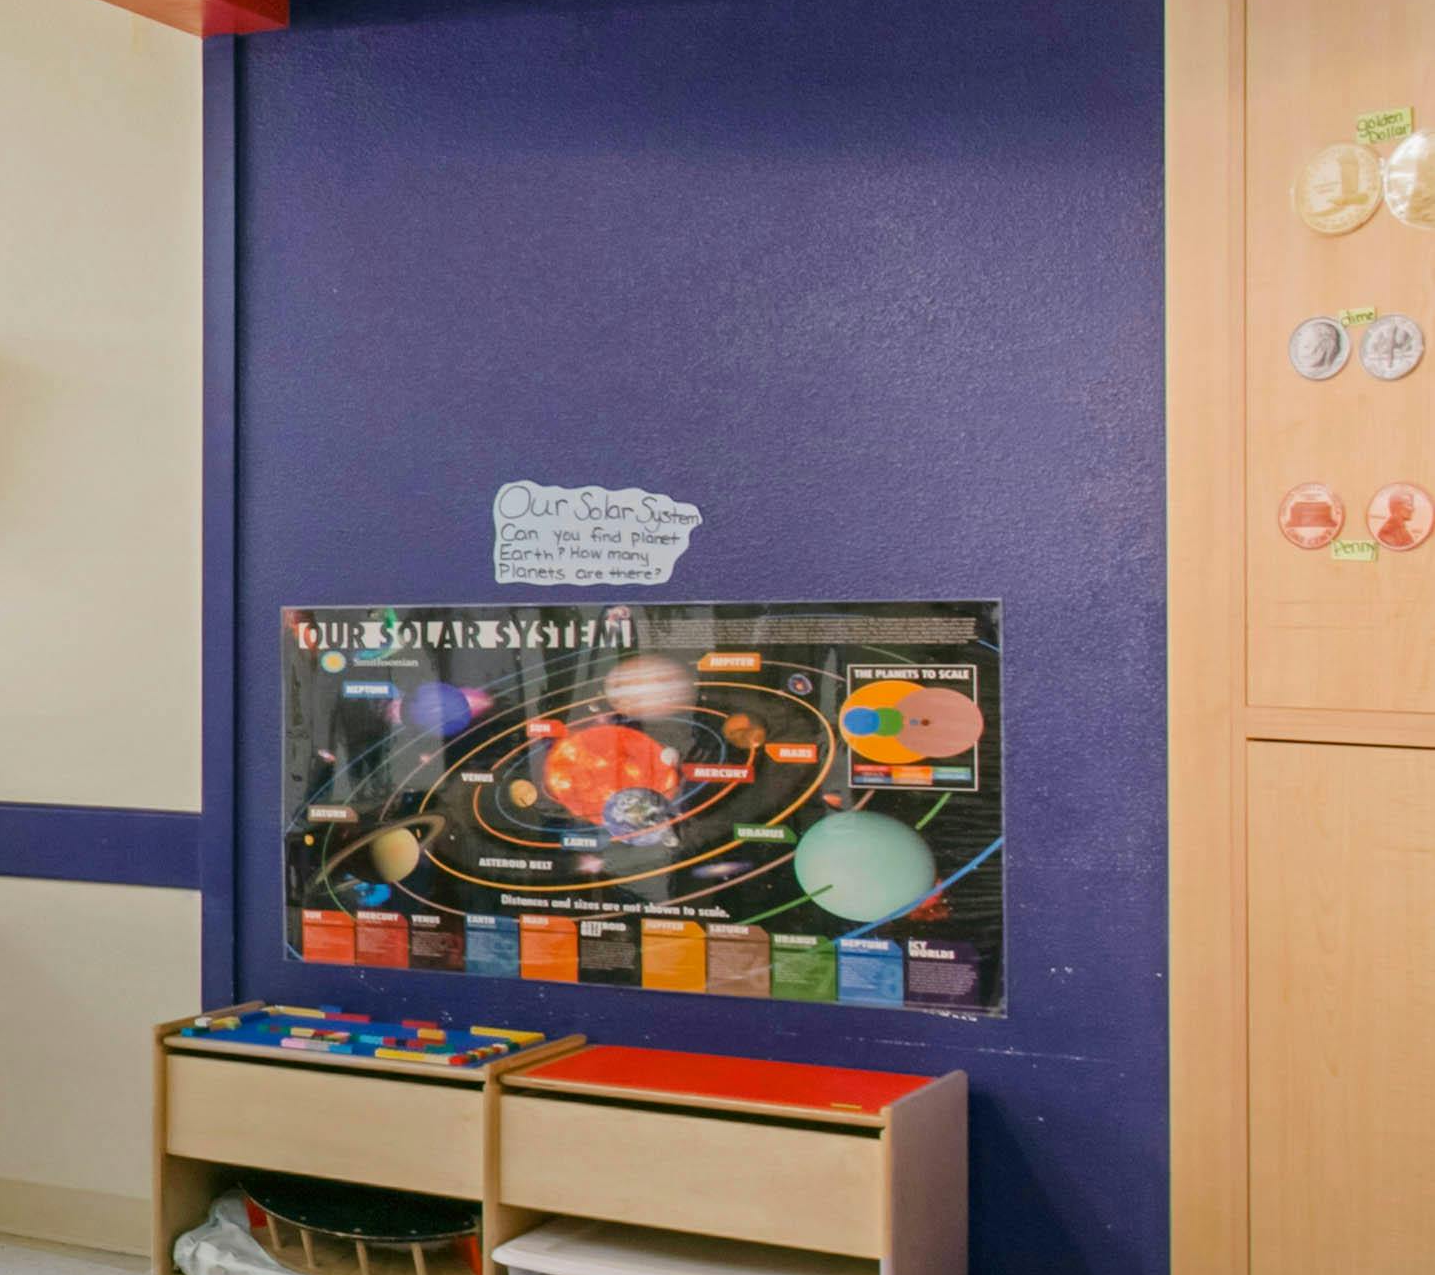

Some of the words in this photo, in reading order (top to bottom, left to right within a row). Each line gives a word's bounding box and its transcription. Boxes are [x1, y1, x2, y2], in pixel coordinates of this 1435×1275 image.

[498, 484, 569, 520] Our
[573, 491, 635, 522] Solar
[635, 495, 701, 533] System
[499, 523, 539, 543] Can
[553, 530, 581, 546] you
[590, 526, 622, 544] find
[630, 531, 681, 546] planet
[570, 546, 603, 560] How
[607, 549, 650, 567] many
[498, 562, 567, 580] Planets
[574, 567, 604, 580] are
[608, 567, 662, 581] there?
[302, 621, 365, 649] OUR
[379, 621, 482, 649] SOLAR
[494, 620, 638, 649] SYSTEM
[352, 657, 420, 669] Smithsonian
[709, 657, 755, 668] JUPITER
[853, 668, 873, 679] THE
[875, 668, 920, 679] PLANETS
[921, 669, 936, 680] TO
[938, 669, 970, 680] SCALE
[345, 684, 390, 696] NEPTUNE
[530, 723, 551, 733] SUN
[779, 747, 812, 759] MARS
[461, 772, 495, 783] VENUS
[693, 767, 749, 779] MERCURY
[310, 809, 347, 819] SATURN
[737, 828, 785, 840] URANUS
[563, 837, 597, 848] EARTH
[478, 857, 527, 870] ASTEROID
[529, 860, 553, 871] BELT
[500, 893, 549, 908] Distances
[551, 898, 571, 910] and
[573, 898, 600, 912] sizes
[602, 902, 621, 913] are
[622, 903, 642, 914] not
[644, 903, 681, 917] shown
[683, 906, 696, 917] to
[698, 906, 731, 919] scale.
[356, 911, 399, 923] MERCURY
[411, 914, 441, 925] VENUS
[708, 924, 750, 936] SATURN
[773, 934, 818, 946] URANUS
[840, 938, 889, 951] NEPTUNE
[908, 949, 955, 961] WORLDS
